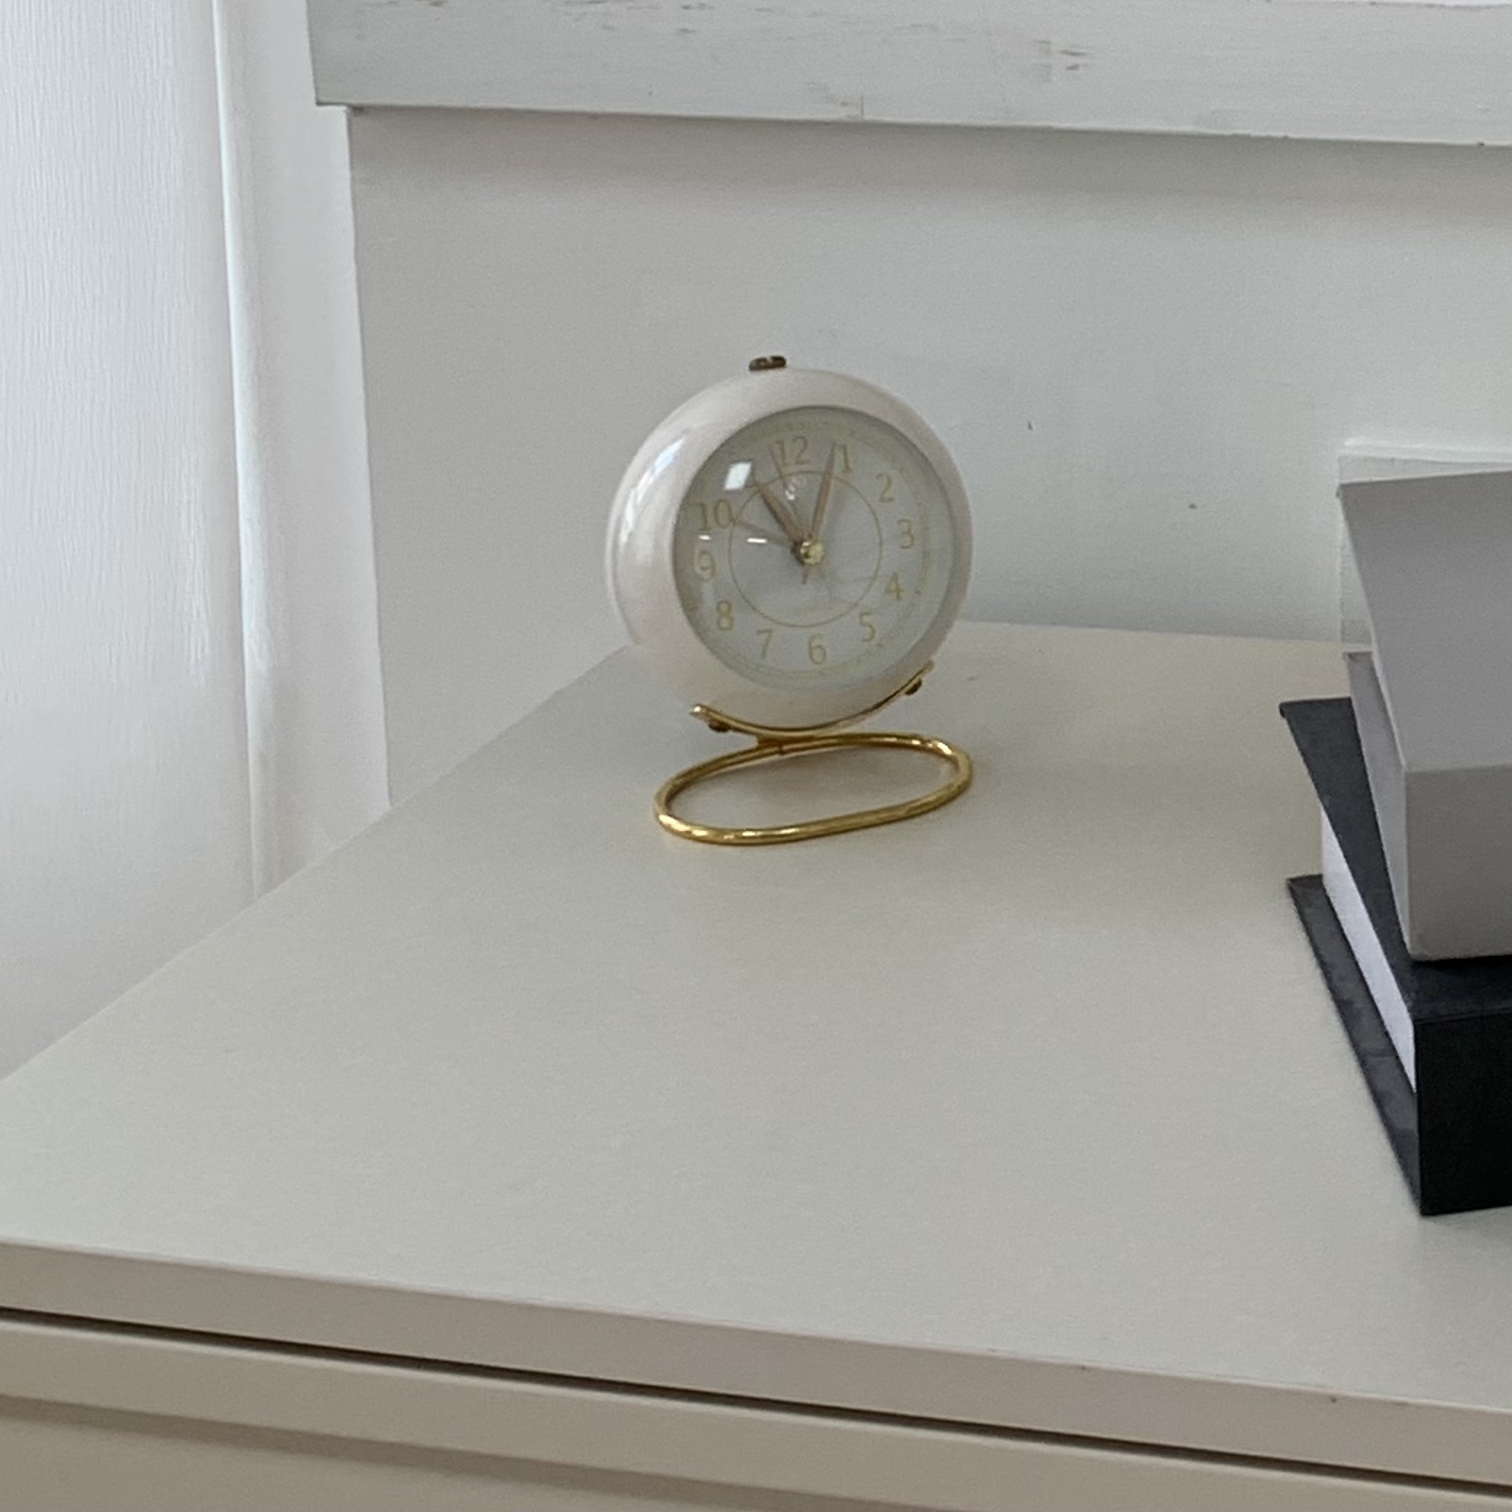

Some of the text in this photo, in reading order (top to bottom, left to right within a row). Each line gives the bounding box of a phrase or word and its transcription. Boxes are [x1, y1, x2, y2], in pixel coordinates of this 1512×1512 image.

[775, 435, 811, 467] 12
[875, 473, 896, 504] 2
[696, 499, 735, 532] 10
[896, 517, 915, 550] 3
[697, 549, 717, 583] 9
[883, 571, 906, 602] 4
[715, 599, 735, 632] 8
[858, 610, 877, 643] 5
[755, 628, 774, 660] 7
[807, 632, 828, 666] 6
